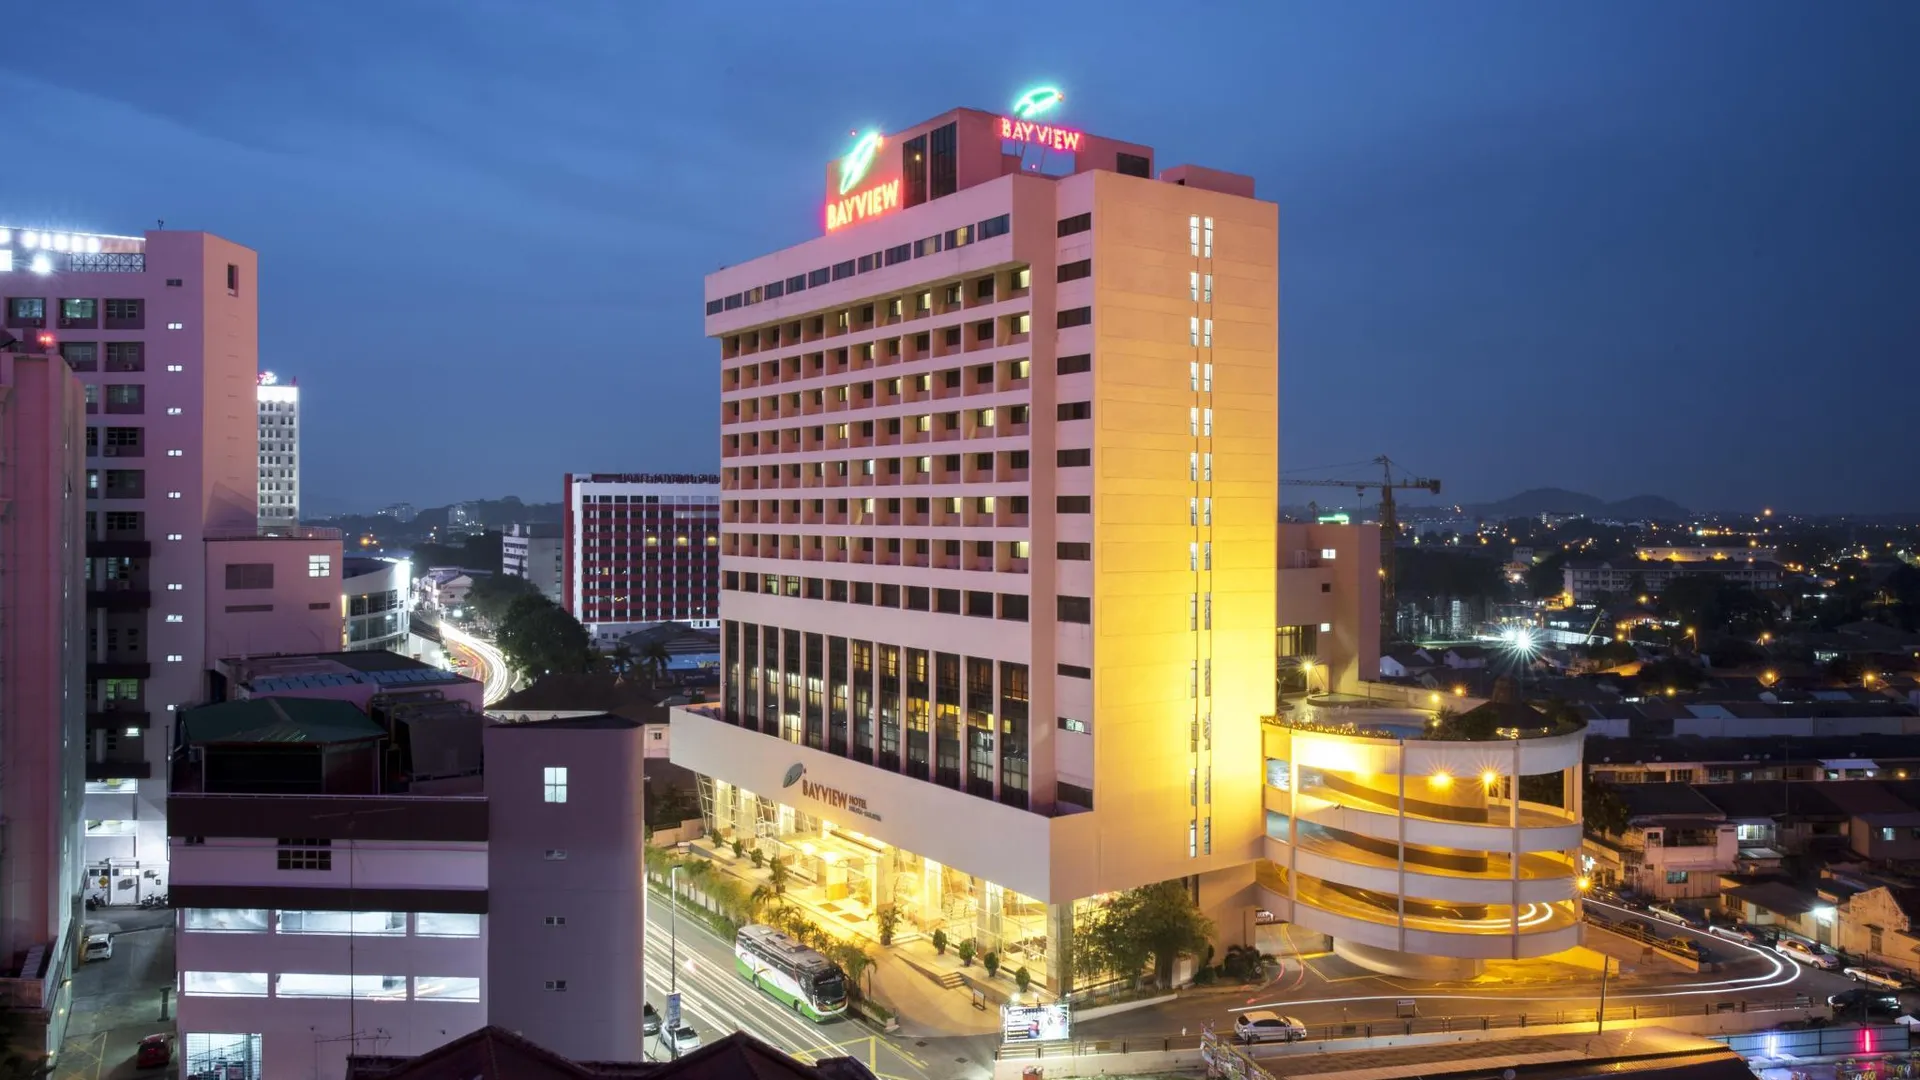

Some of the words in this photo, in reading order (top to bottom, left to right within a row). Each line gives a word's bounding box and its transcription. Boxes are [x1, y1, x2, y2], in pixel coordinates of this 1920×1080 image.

[1001, 117, 1079, 150] BAYVIEW
[827, 178, 899, 230] BAYVIEW
[802, 779, 847, 809] BAYVIEW
[849, 795, 867, 809] HOTEL
